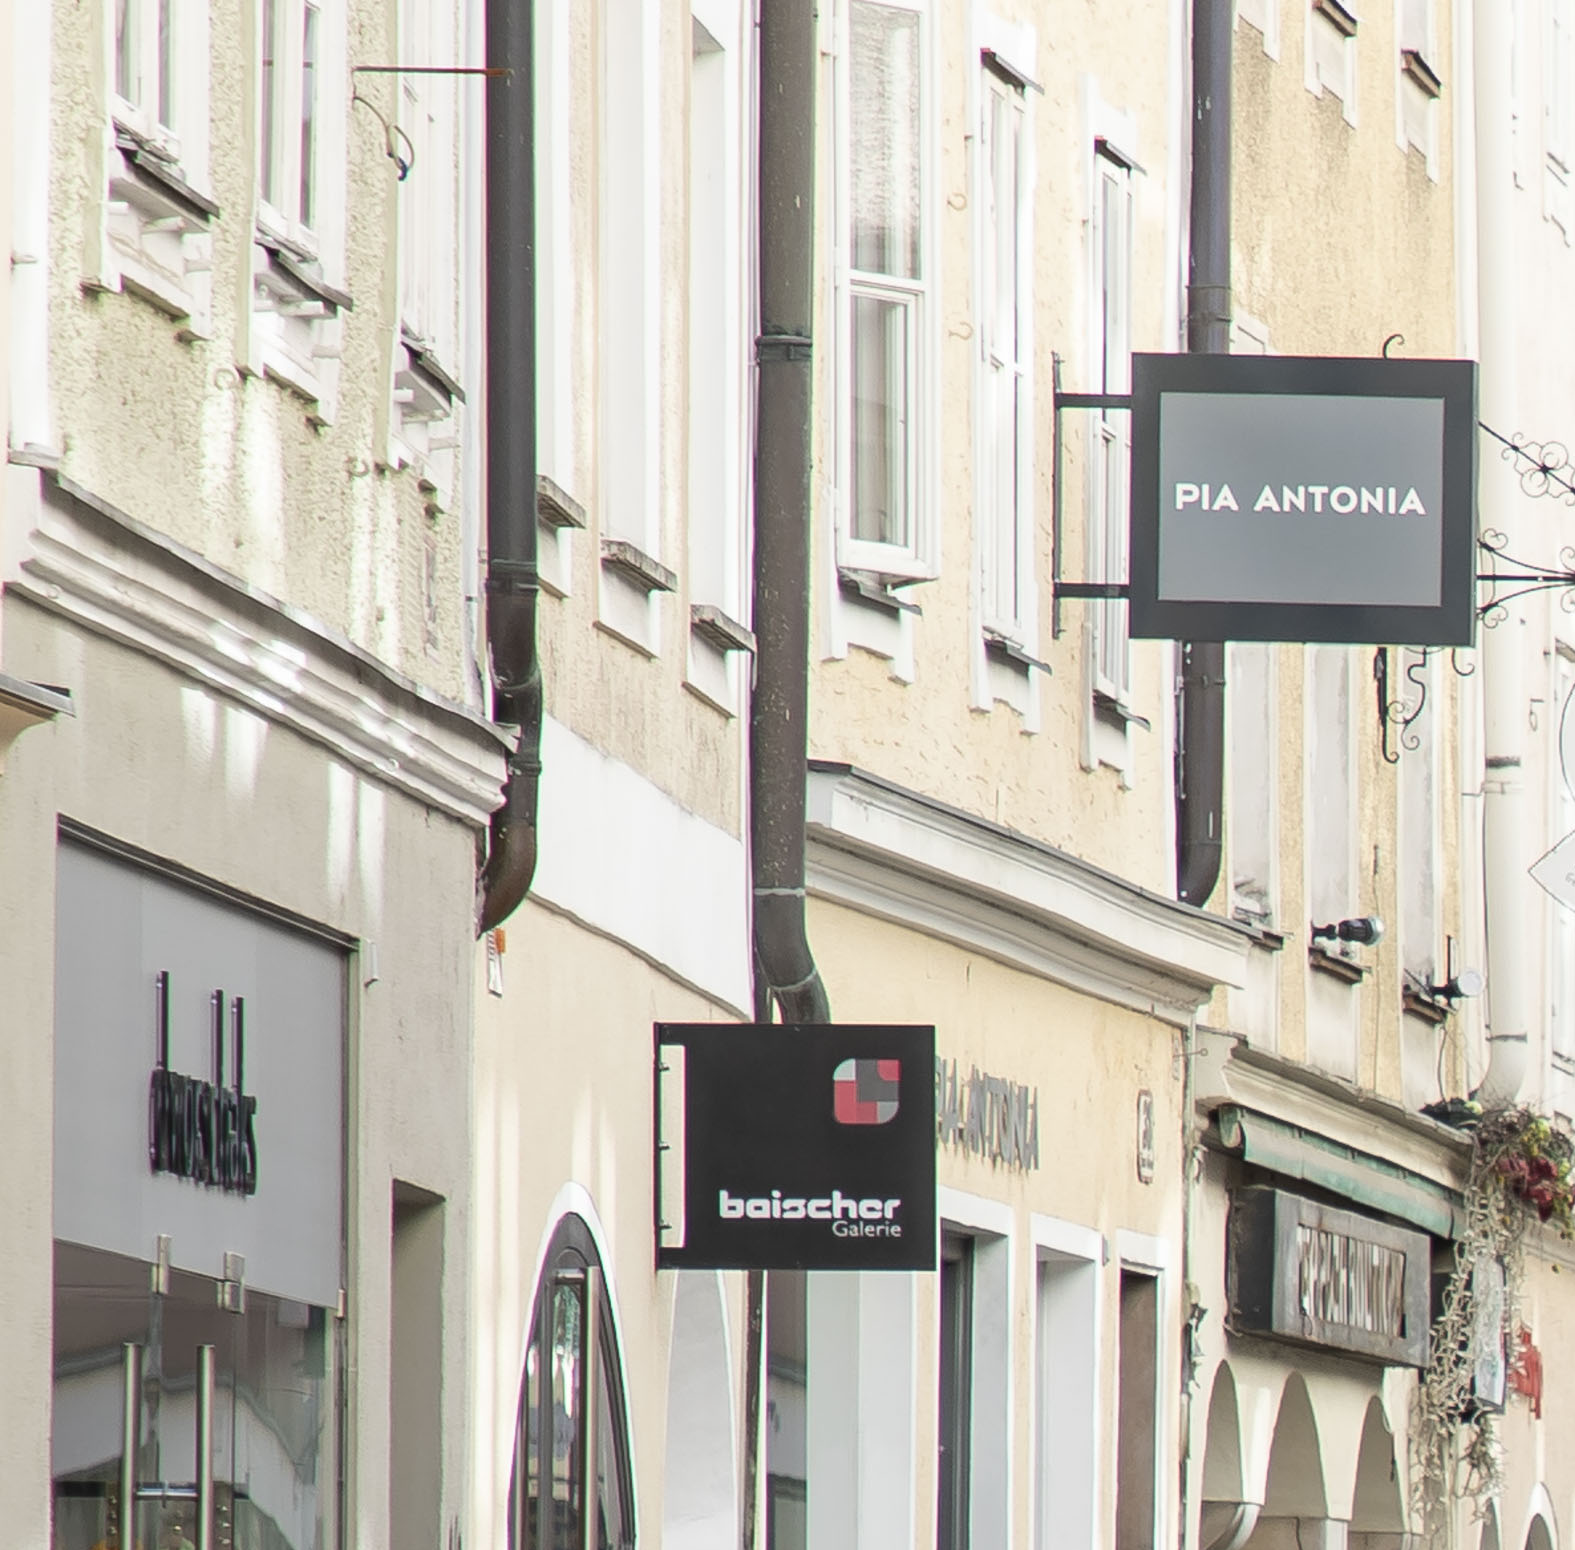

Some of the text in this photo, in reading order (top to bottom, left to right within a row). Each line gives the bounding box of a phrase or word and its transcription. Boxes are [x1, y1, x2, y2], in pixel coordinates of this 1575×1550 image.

[1174, 483, 1427, 515] PIA ANTONIA
[718, 1189, 901, 1220] baischer
[832, 1220, 902, 1238] Galerie
